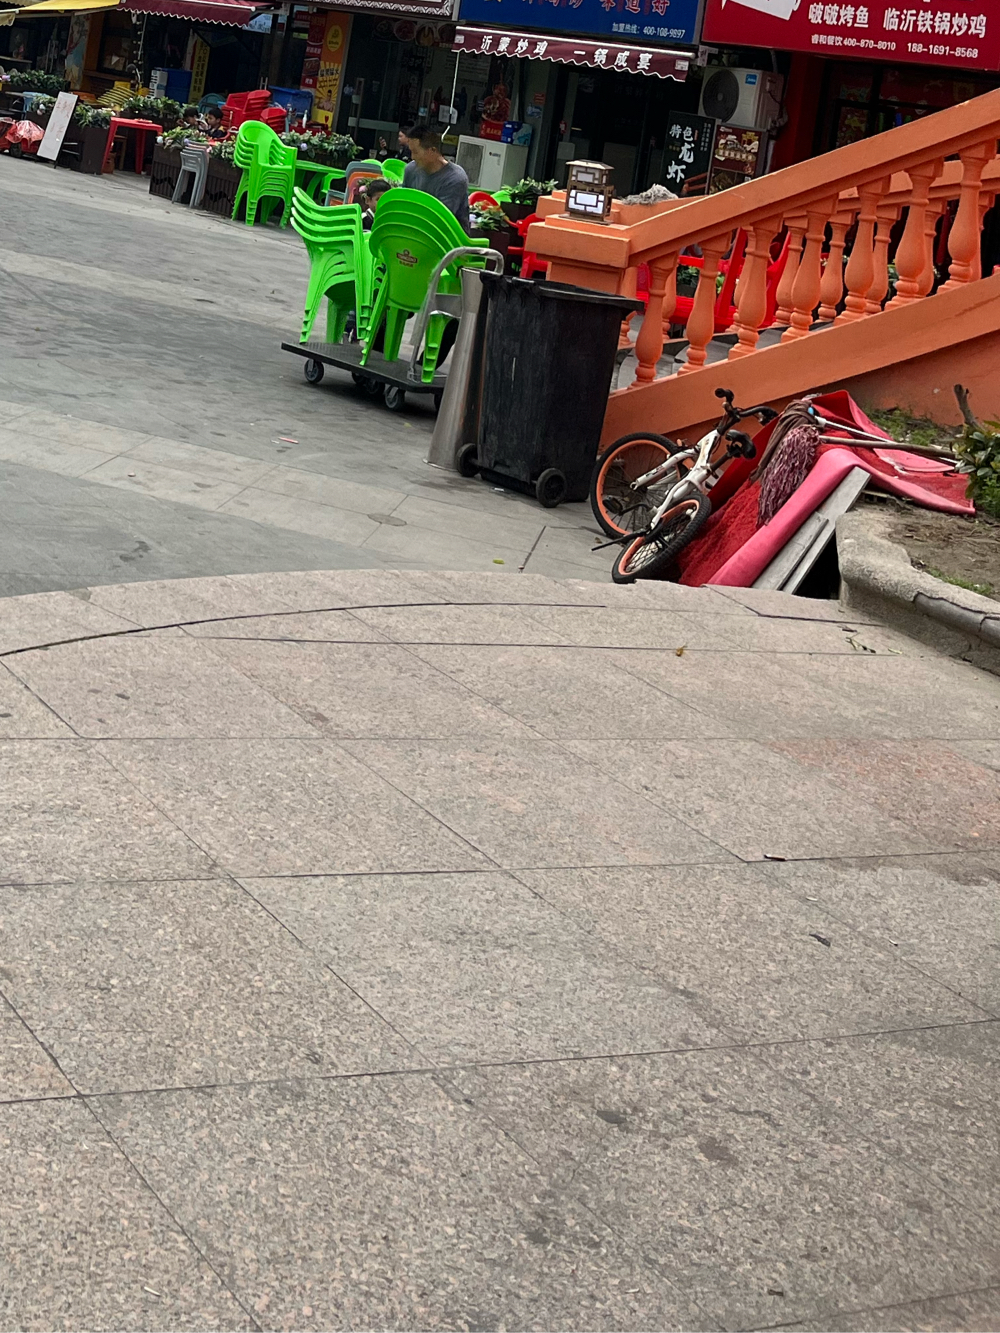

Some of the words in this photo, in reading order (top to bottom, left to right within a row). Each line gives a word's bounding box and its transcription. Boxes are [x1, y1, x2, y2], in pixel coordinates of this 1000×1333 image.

[643, 27, 686, 40] 400-108-9897
[808, 2, 870, 28] 啵啵烤鱼
[883, 7, 988, 39] 临沂铁锅炒鸡
[481, 35, 549, 56] 沂蒙炒鸡
[573, 48, 654, 71] 一锅成宴
[843, 37, 897, 52] 400-870-8010
[906, 42, 979, 60] 188-1691-8568
[669, 123, 694, 142] 特色
[666, 142, 695, 184] 龙虾
